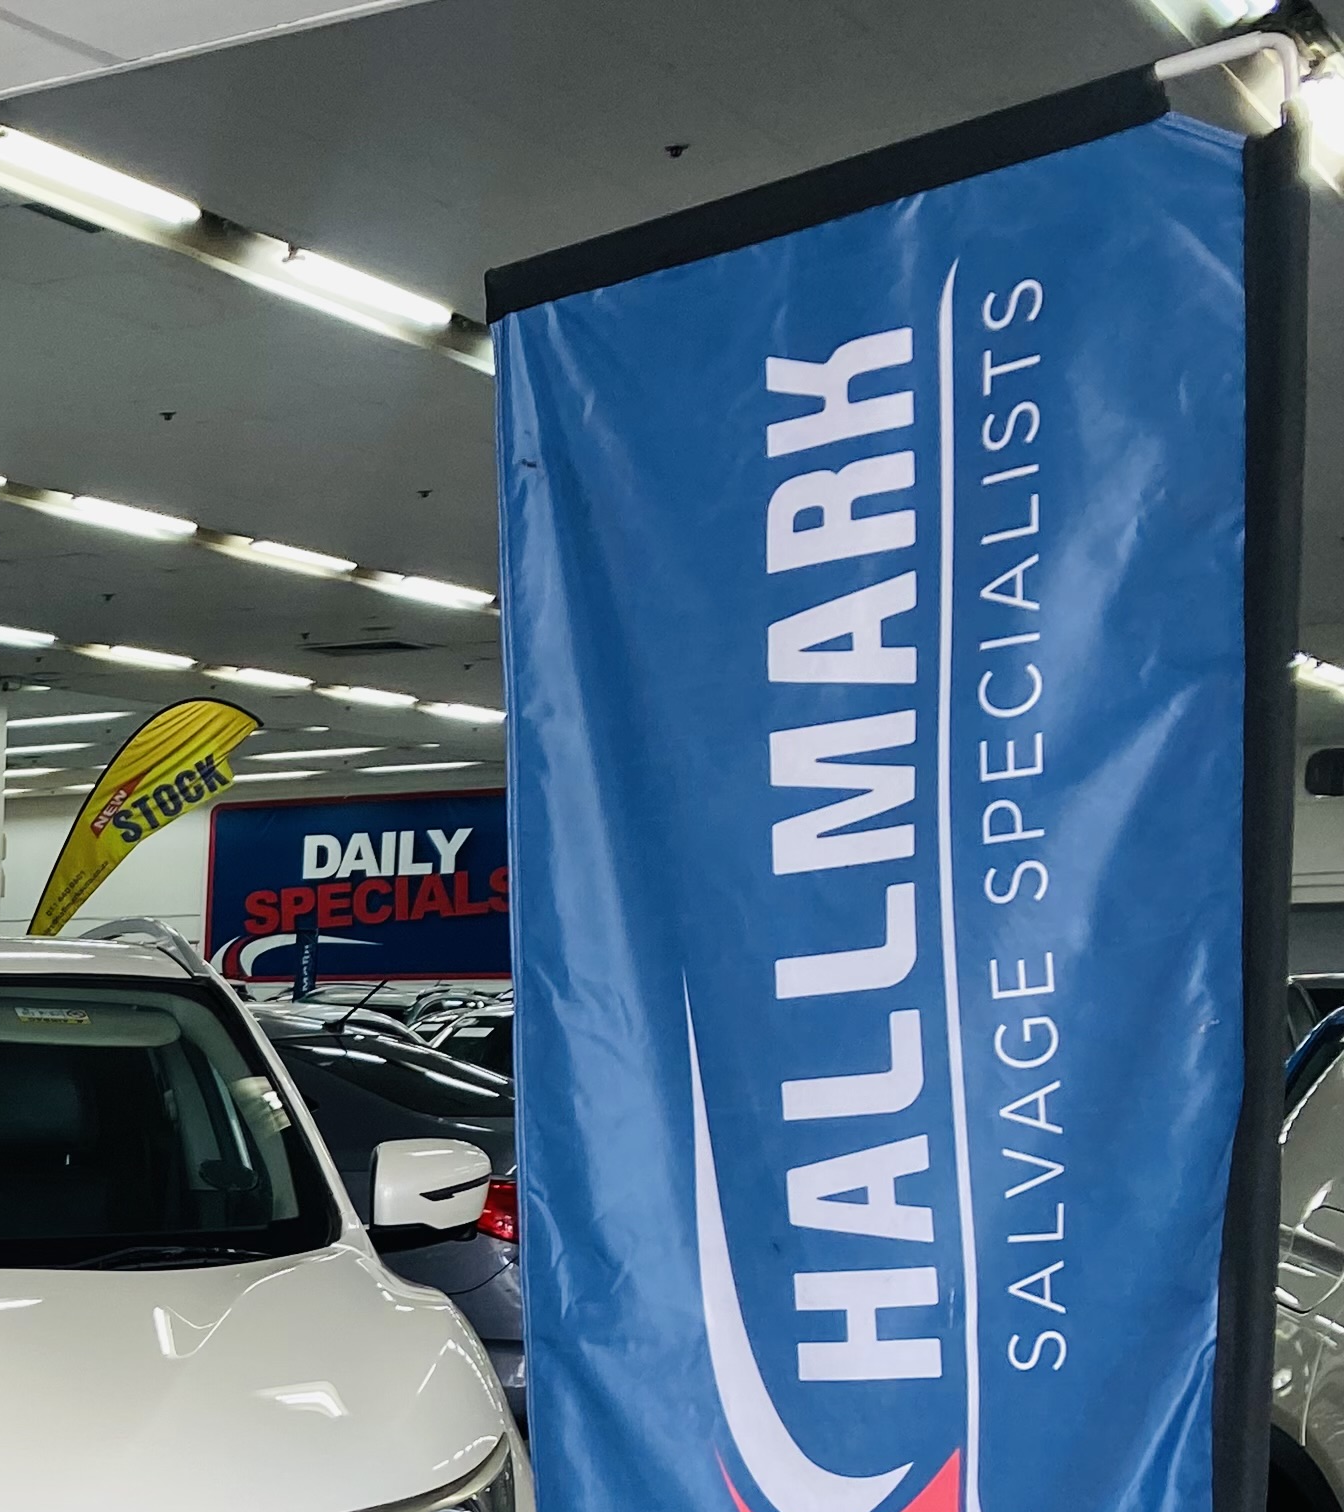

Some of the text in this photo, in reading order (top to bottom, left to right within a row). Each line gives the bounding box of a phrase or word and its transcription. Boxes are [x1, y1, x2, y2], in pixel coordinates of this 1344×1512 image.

[94, 789, 128, 829] NEW
[112, 753, 231, 843] STOCK
[977, 278, 1067, 1371] SALVAGE SPECIALISTS
[302, 827, 474, 880] DAILY
[765, 327, 943, 1382] HALLMARK
